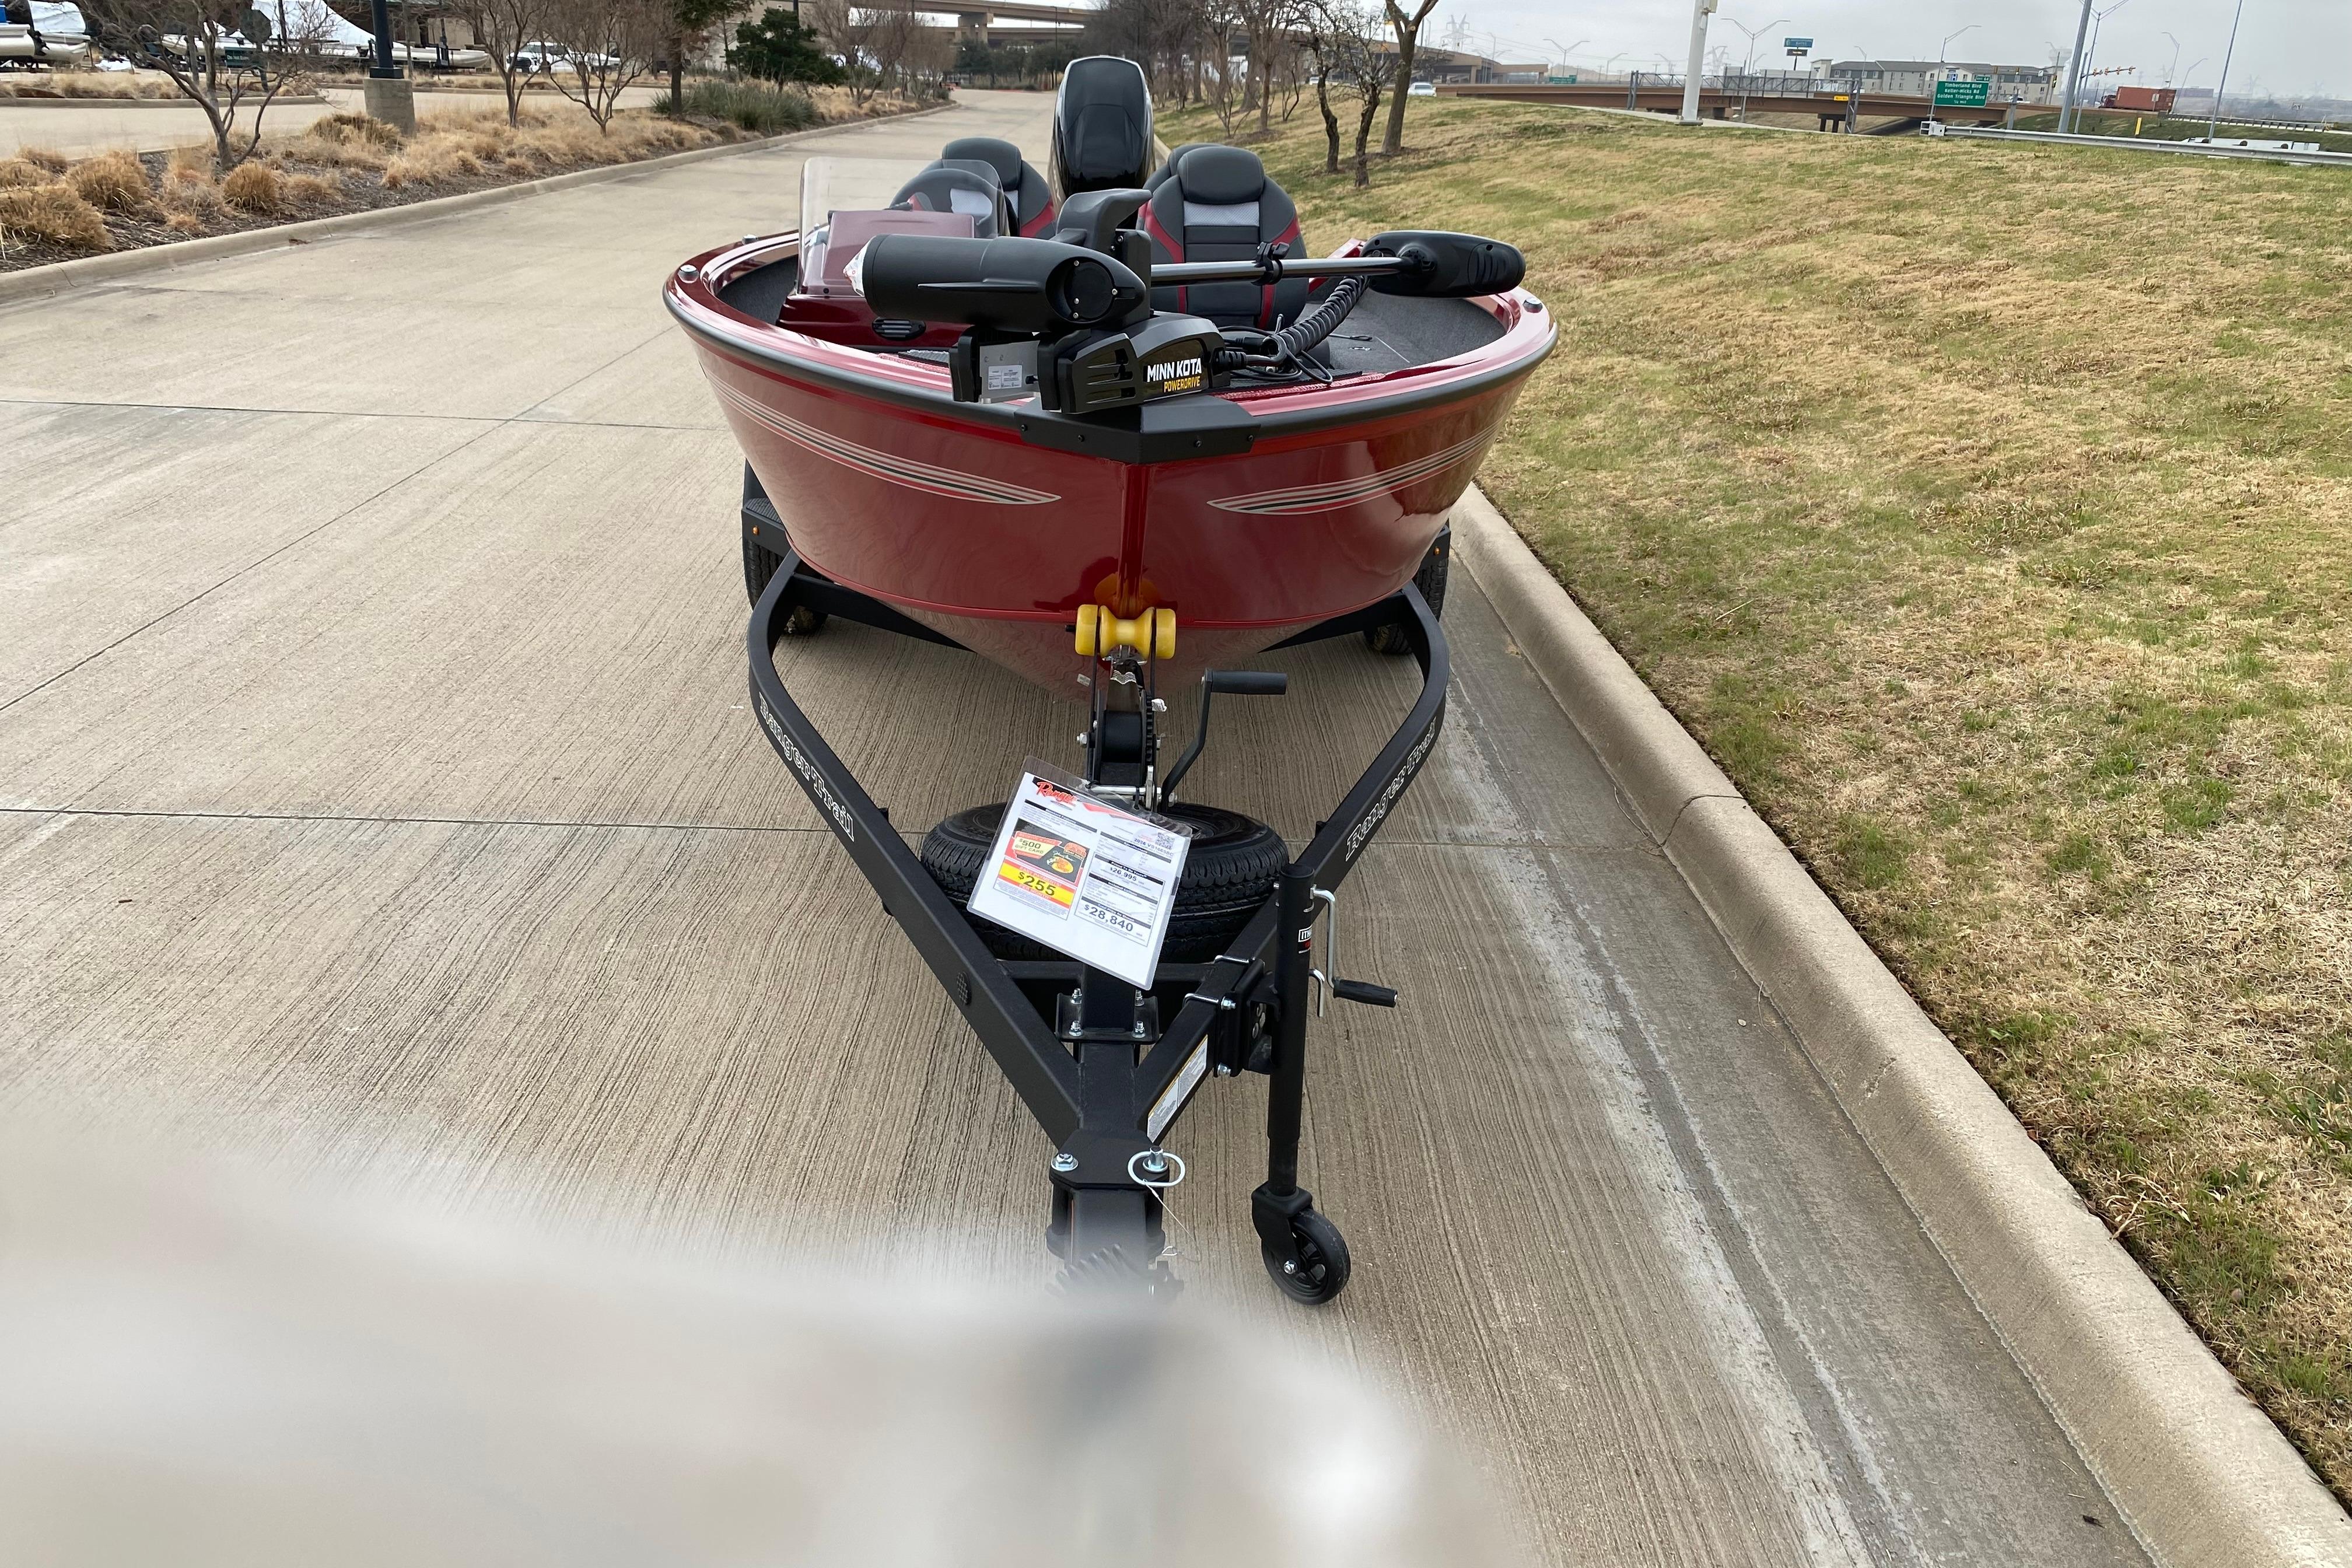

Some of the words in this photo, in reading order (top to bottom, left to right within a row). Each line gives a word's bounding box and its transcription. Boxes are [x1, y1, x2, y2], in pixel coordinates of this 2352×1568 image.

[1147, 362, 1175, 383] MINN
[1176, 358, 1202, 378] KOTA
[1164, 376, 1200, 393] POWERDRIVE
[759, 692, 810, 781] Ranger
[811, 765, 855, 842] Trail
[1037, 782, 1078, 802] Ranger
[1345, 765, 1406, 862] Ranger
[1019, 838, 1041, 849] $500
[1018, 872, 1056, 896] $255
[1084, 904, 1133, 932] $28,840
